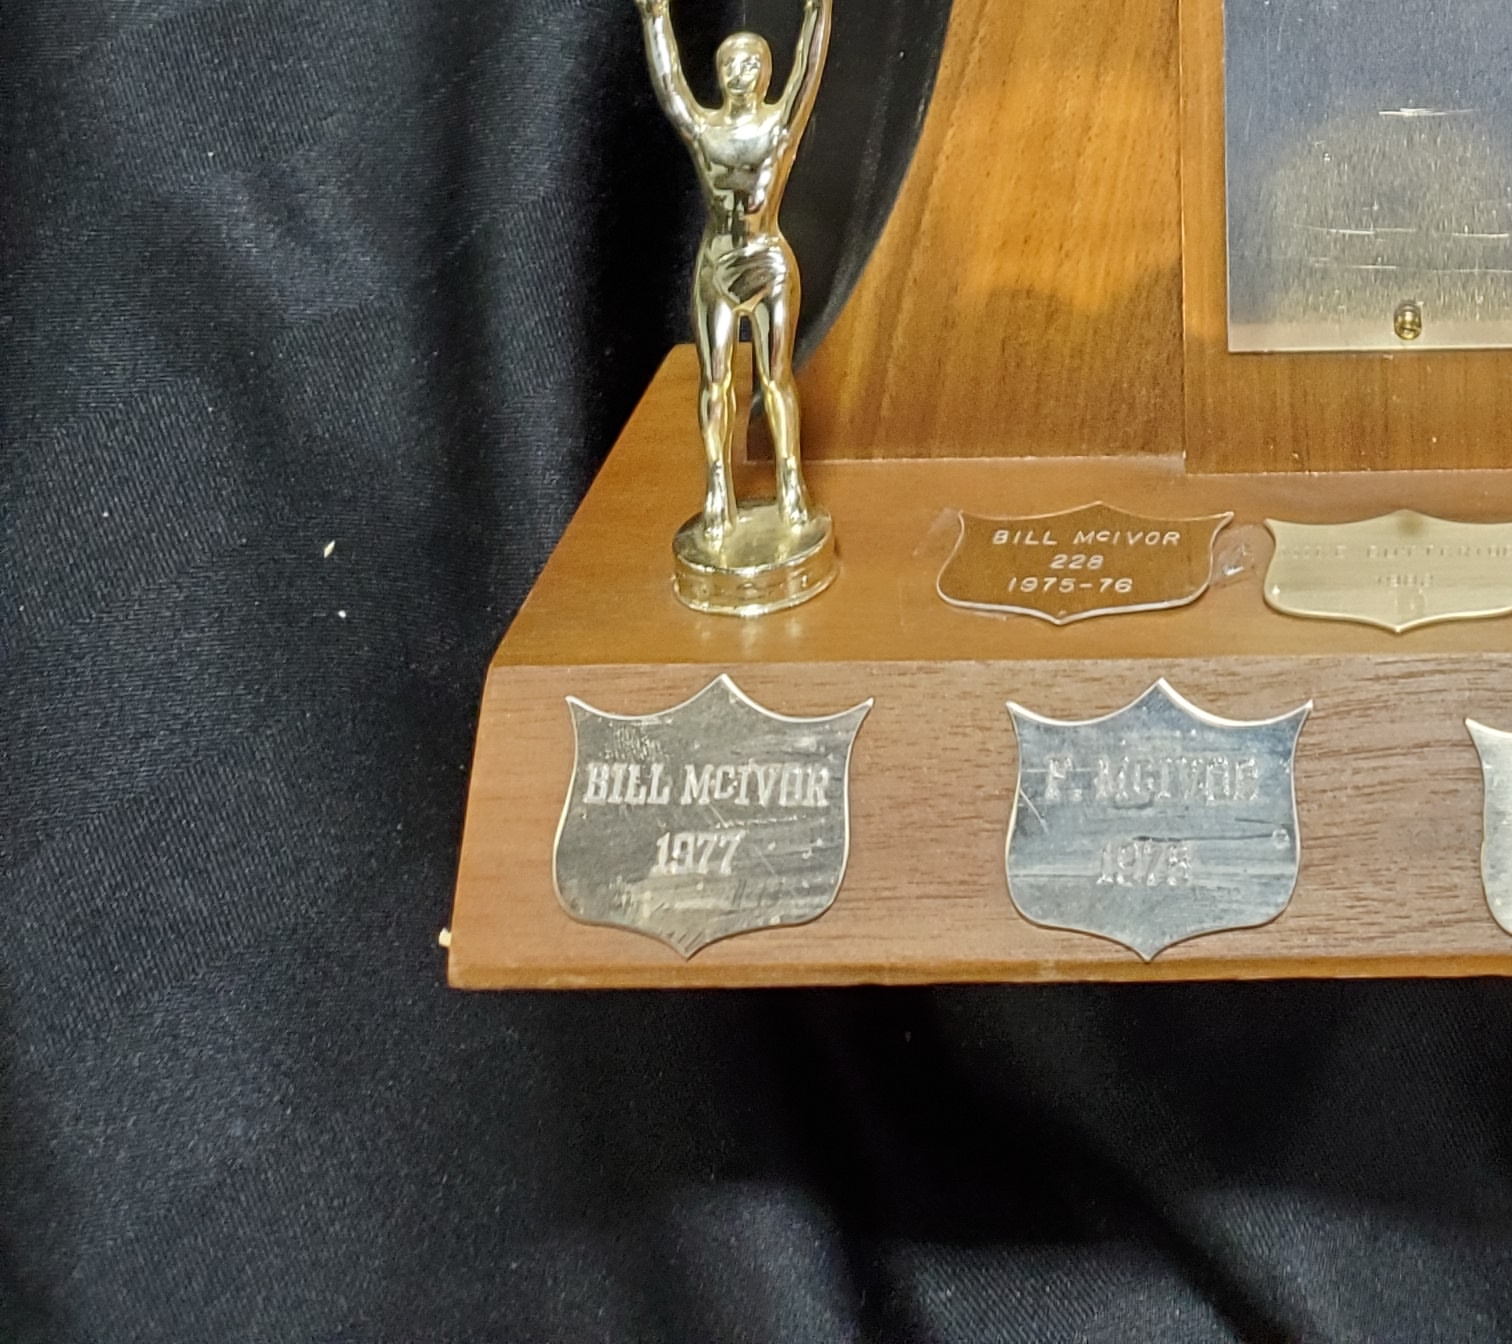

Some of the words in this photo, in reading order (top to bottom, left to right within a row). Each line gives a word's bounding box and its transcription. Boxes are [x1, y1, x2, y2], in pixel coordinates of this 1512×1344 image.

[992, 529, 1058, 545] BILL
[1050, 553, 1104, 570] 228
[1008, 577, 1134, 594] 1975-76
[583, 762, 672, 806] BILL
[650, 830, 747, 876] 1977
